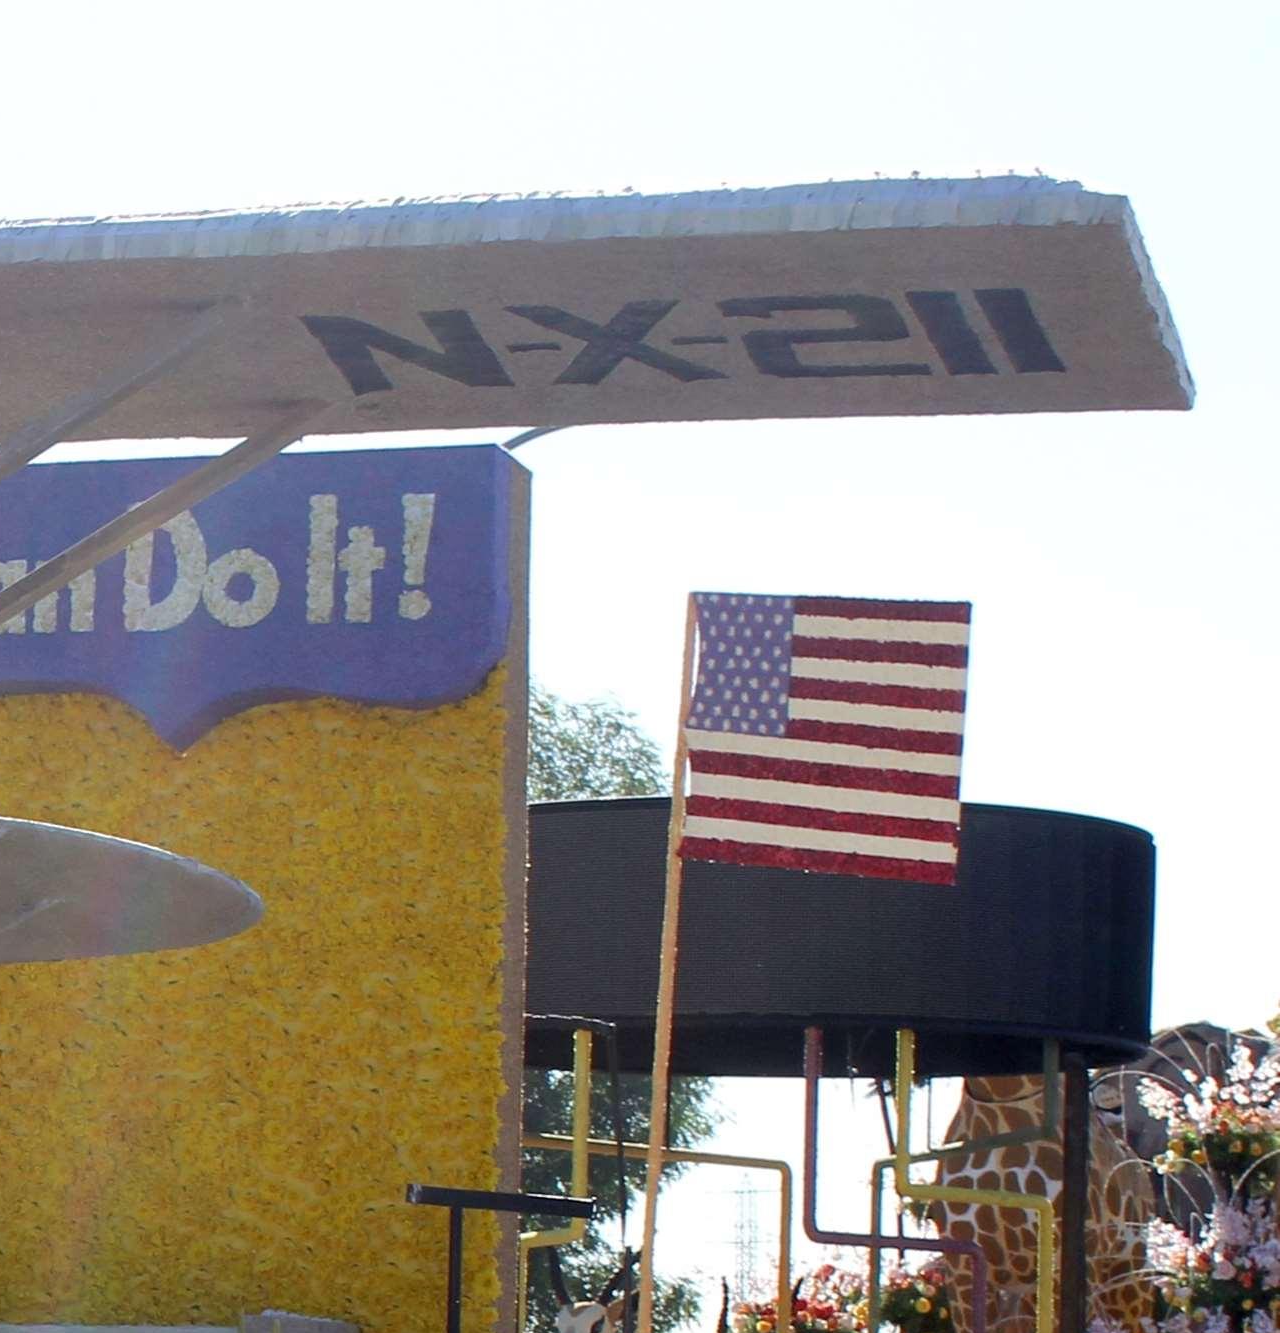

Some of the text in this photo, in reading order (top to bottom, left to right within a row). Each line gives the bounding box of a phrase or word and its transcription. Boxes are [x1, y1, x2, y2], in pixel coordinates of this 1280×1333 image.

[296, 287, 1067, 396] N-X-211
[123, 499, 281, 632] Do
[306, 493, 436, 620] It!
